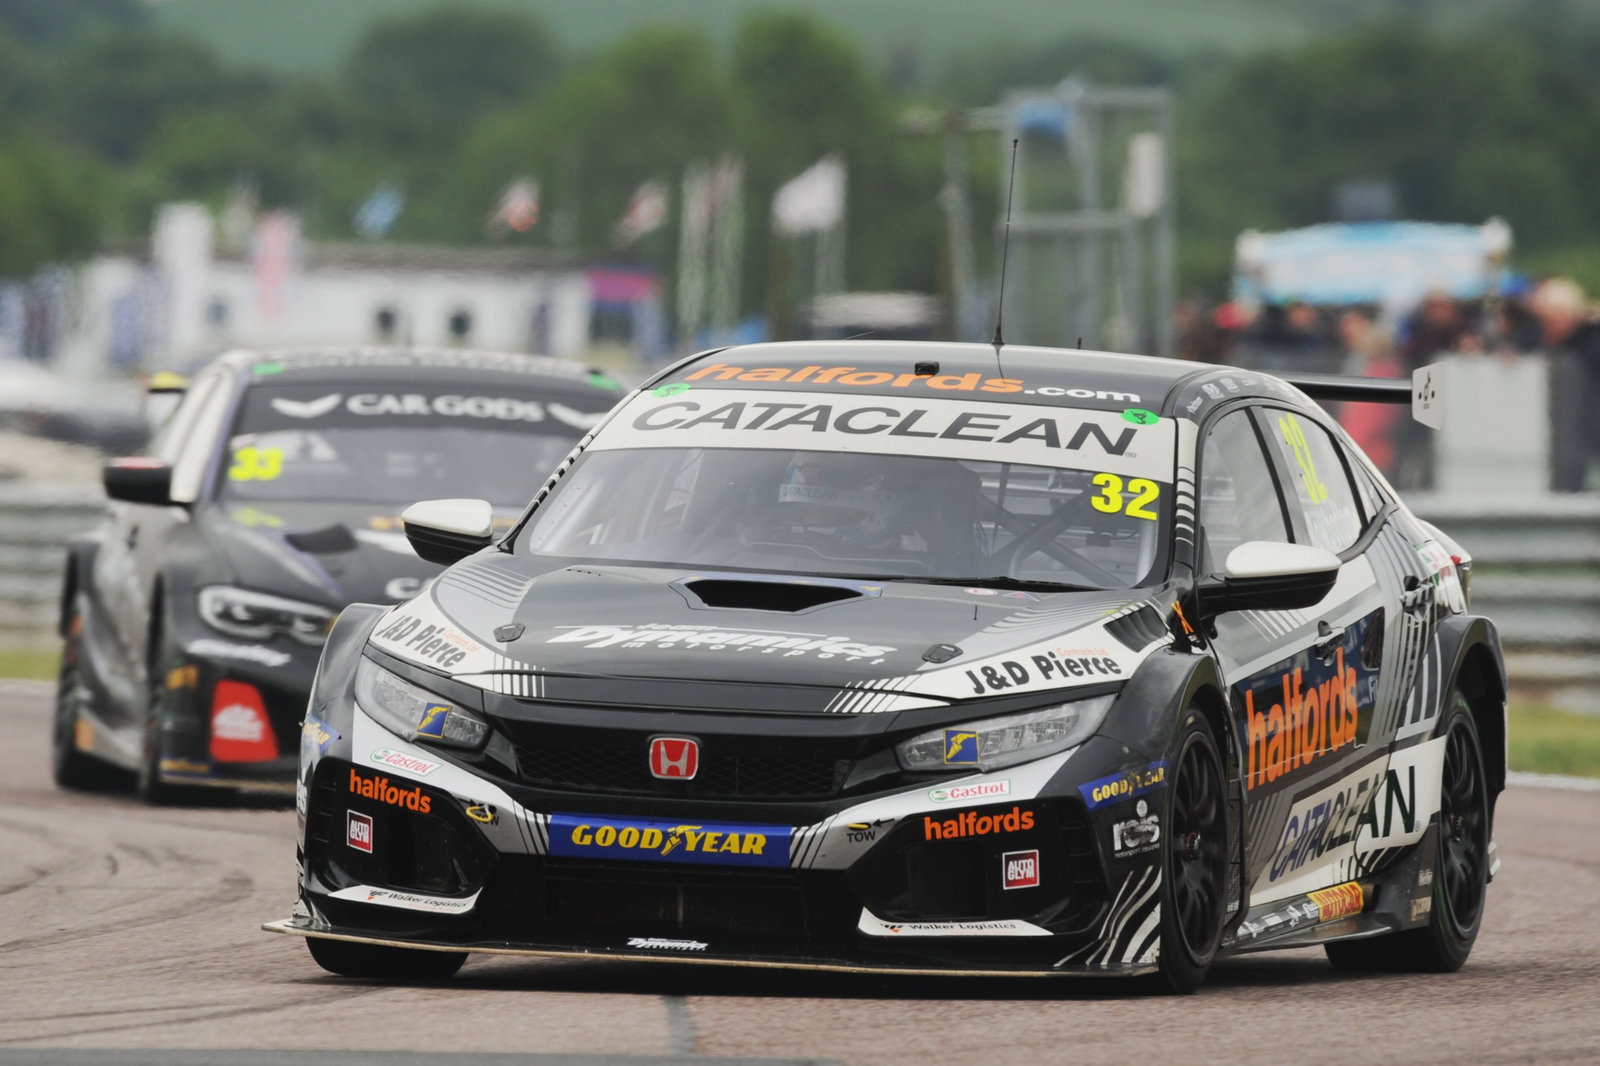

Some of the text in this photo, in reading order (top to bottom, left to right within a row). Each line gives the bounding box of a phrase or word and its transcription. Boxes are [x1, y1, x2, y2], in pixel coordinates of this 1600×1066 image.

[684, 363, 1141, 403] halfords.com
[346, 393, 545, 421] CAR GODS
[632, 401, 1138, 457] CATACLEAN
[227, 446, 284, 481] 33
[1090, 473, 1160, 520] 32
[375, 615, 467, 668] J&D Pierce
[964, 651, 1122, 695] J&D Pierce
[1245, 646, 1359, 791] halfords
[385, 753, 434, 774] Castrol
[350, 768, 432, 814] halfords
[950, 783, 1006, 799] Castrol
[846, 831, 877, 843] TOW
[924, 806, 1035, 841] halfords
[1268, 765, 1416, 882] CATACLEAN
[1008, 858, 1035, 871] AUTO
[1008, 868, 1035, 881] GLYM
[389, 893, 424, 904] Walker
[909, 922, 1017, 932] Walker Logistics
